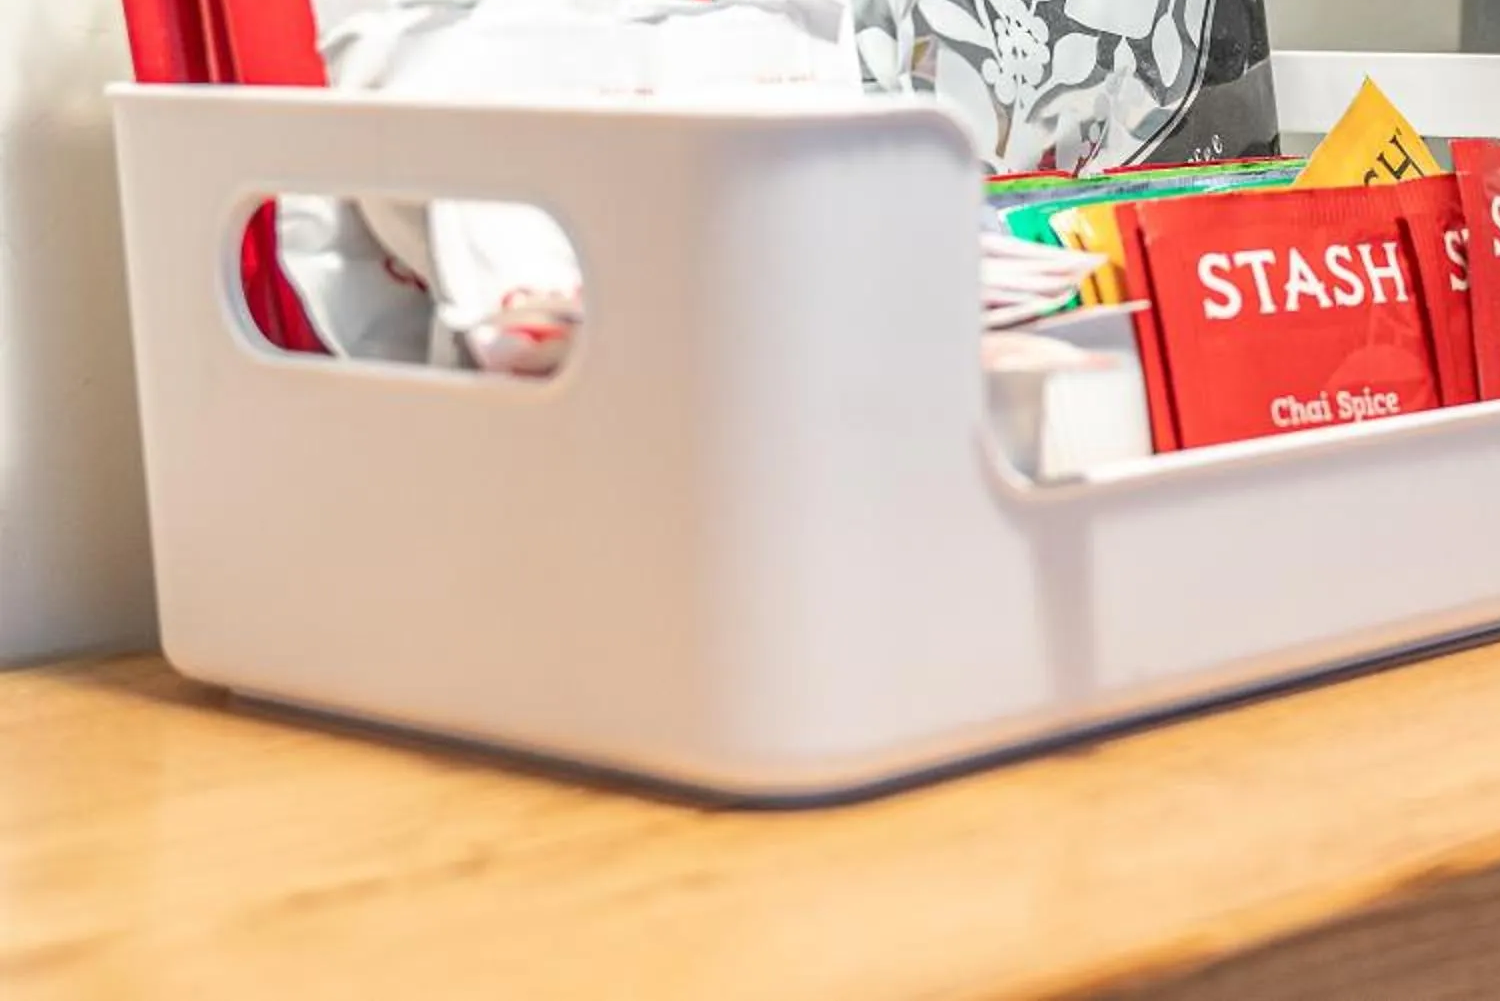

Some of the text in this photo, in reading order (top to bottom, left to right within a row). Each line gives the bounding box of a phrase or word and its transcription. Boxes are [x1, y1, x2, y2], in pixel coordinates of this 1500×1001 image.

[1197, 241, 1409, 320] STASH
[1270, 385, 1399, 428] Chai Spice
